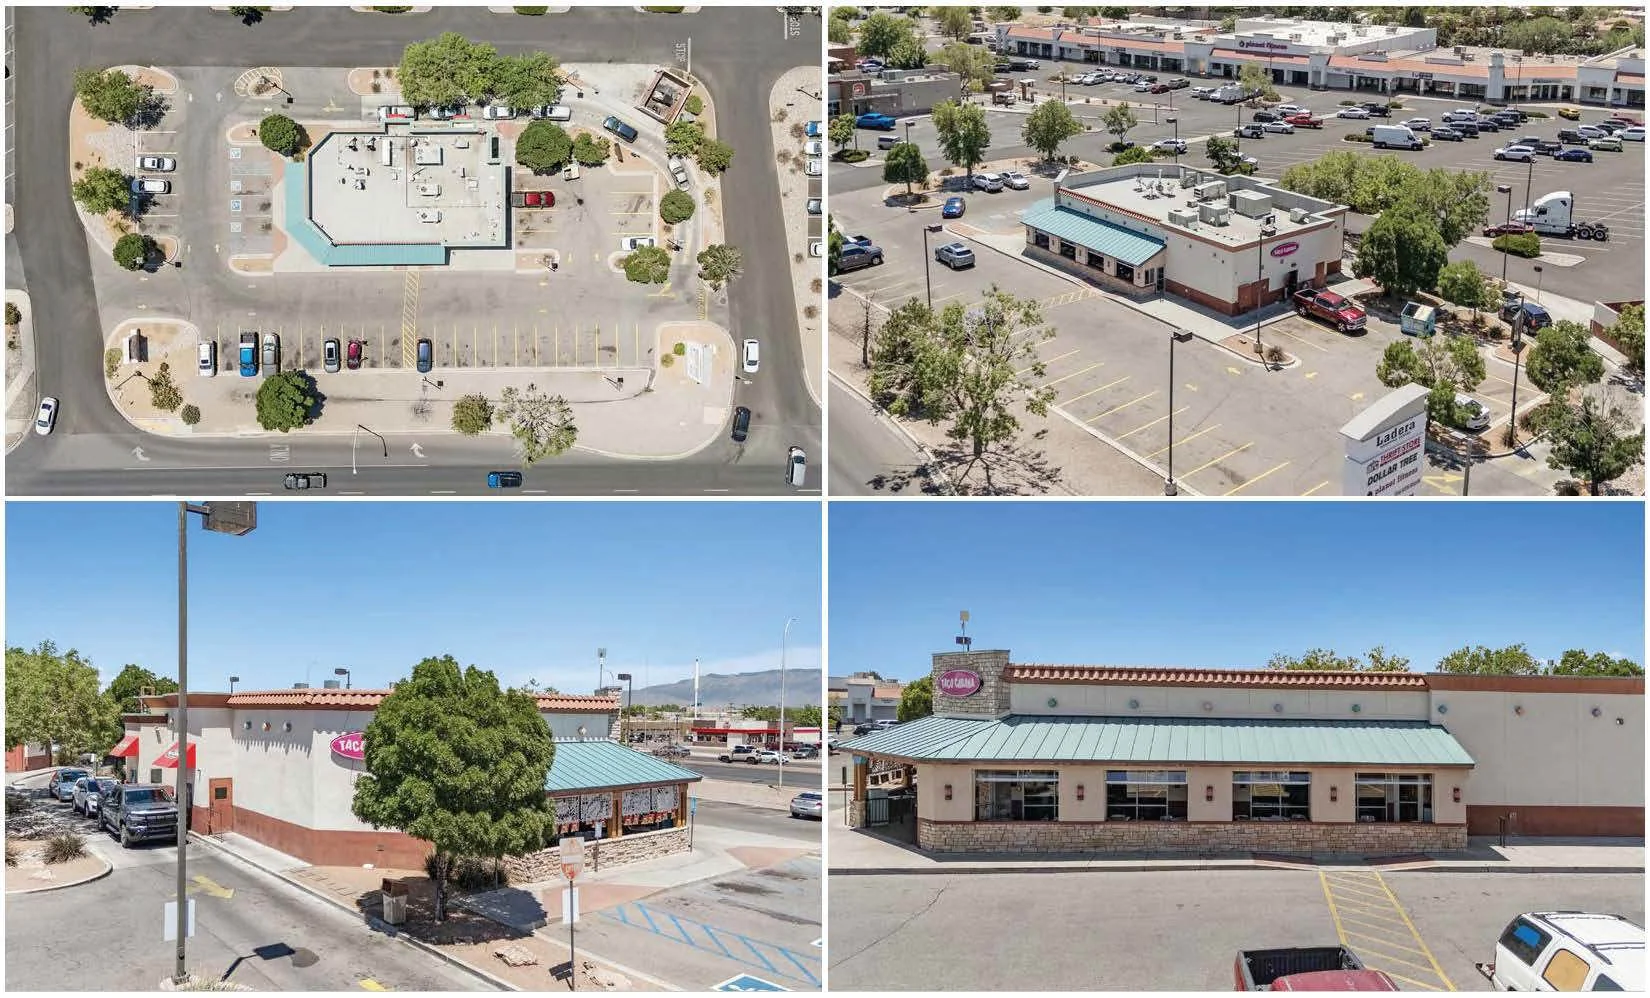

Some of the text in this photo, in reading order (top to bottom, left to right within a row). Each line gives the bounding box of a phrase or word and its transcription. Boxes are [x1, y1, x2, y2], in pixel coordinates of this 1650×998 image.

[1376, 421, 1415, 446] Ladera
[1380, 447, 1401, 462] THRIFT
[1402, 437, 1421, 452] STORE
[1367, 453, 1418, 486] DOLLAR TREE
[1375, 478, 1396, 496] planet
[1397, 467, 1418, 483] fitness
